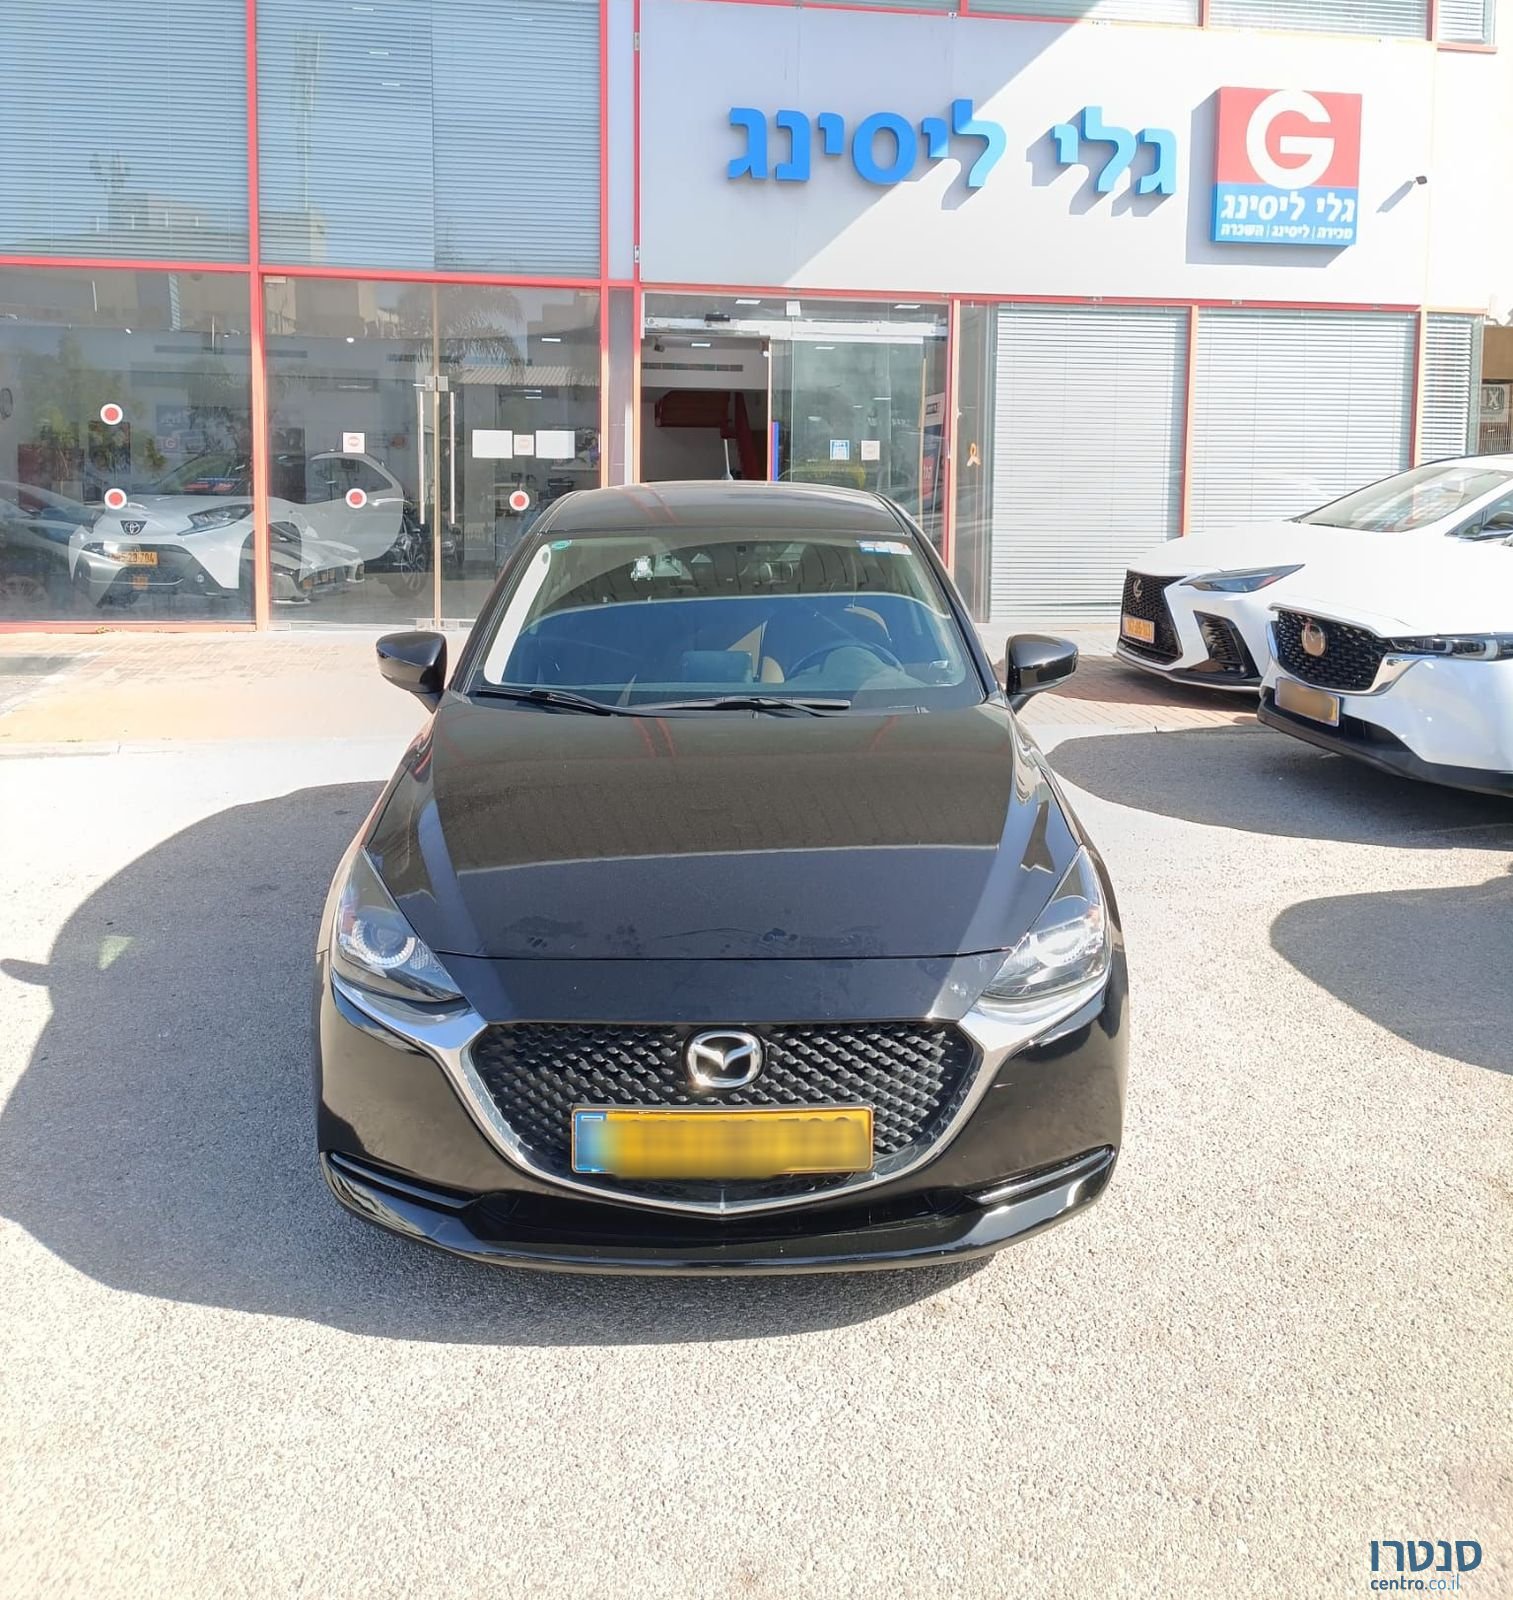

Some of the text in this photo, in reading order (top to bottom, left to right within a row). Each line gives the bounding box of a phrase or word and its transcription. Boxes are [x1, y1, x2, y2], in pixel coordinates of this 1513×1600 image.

[727, 98, 1177, 195] גלי ליסינג
[1246, 89, 1336, 190] G
[1220, 190, 1356, 223] גלי ליסינג
[1220, 222, 1265, 236] השכרה
[1271, 224, 1311, 238] ליסינג
